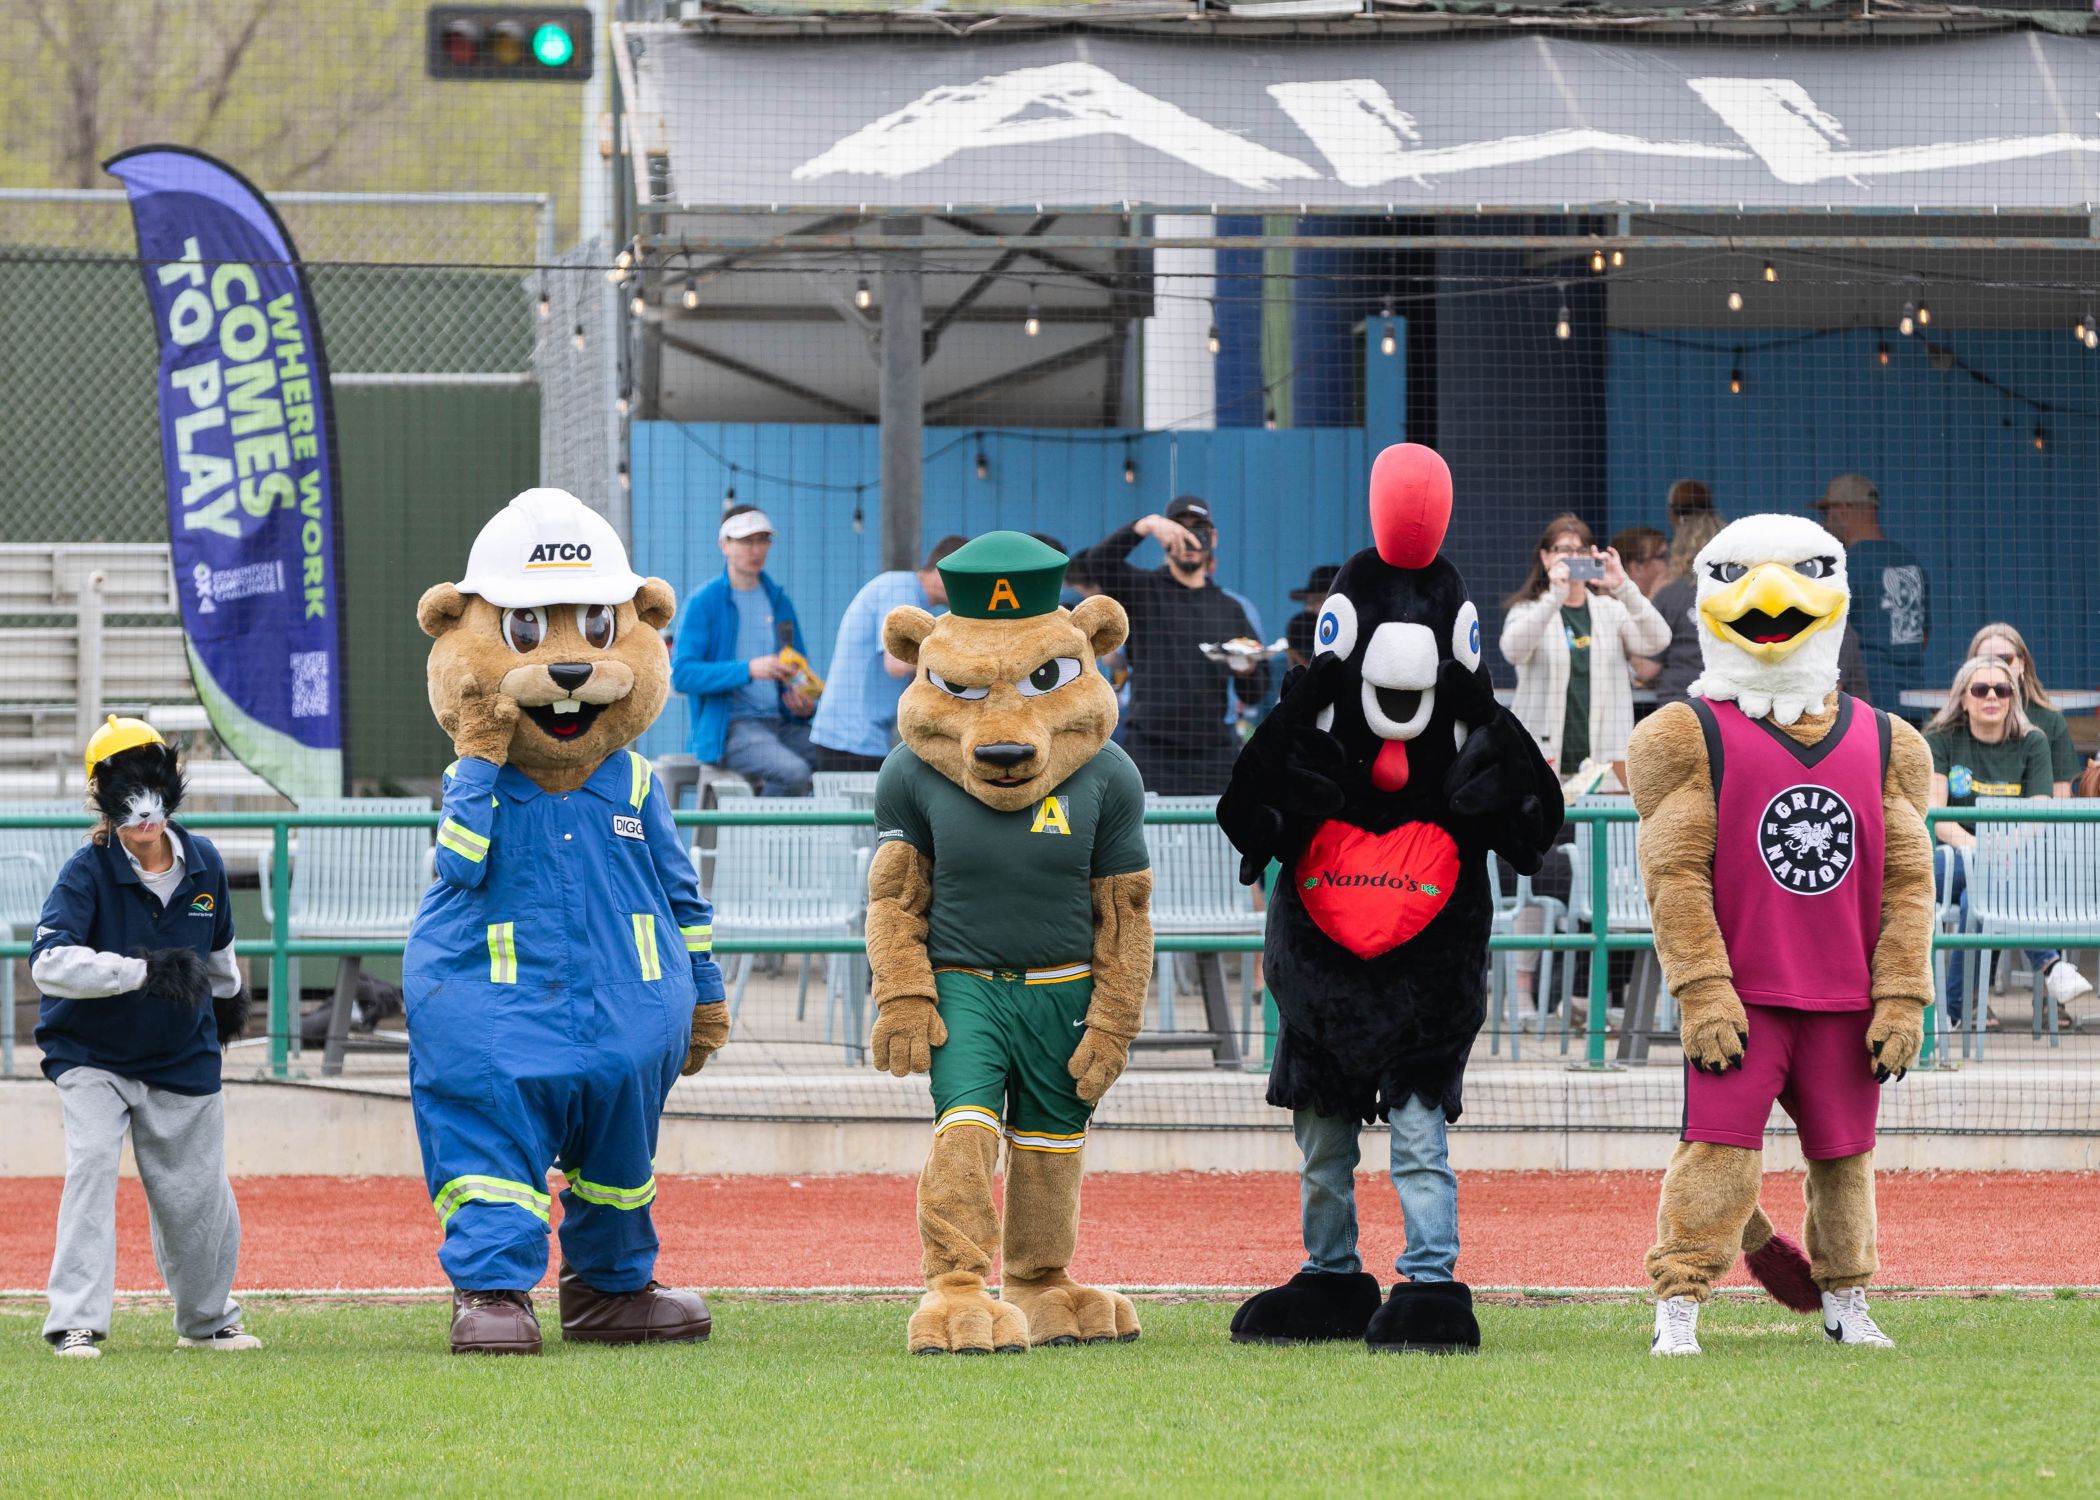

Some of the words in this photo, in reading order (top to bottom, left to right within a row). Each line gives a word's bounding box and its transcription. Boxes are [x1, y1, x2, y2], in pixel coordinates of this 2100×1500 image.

[157, 236, 214, 346] TO
[211, 263, 296, 518] COMES
[171, 359, 241, 538] PLAY
[267, 293, 318, 460] WHERE
[299, 470, 326, 620] WORK
[528, 543, 592, 562] ATCO
[987, 578, 1020, 611] A
[1030, 796, 1072, 835] A
[1775, 792, 1848, 825] GRIFF
[1319, 869, 1419, 892] Nando's
[1766, 844, 1848, 888] NATION
